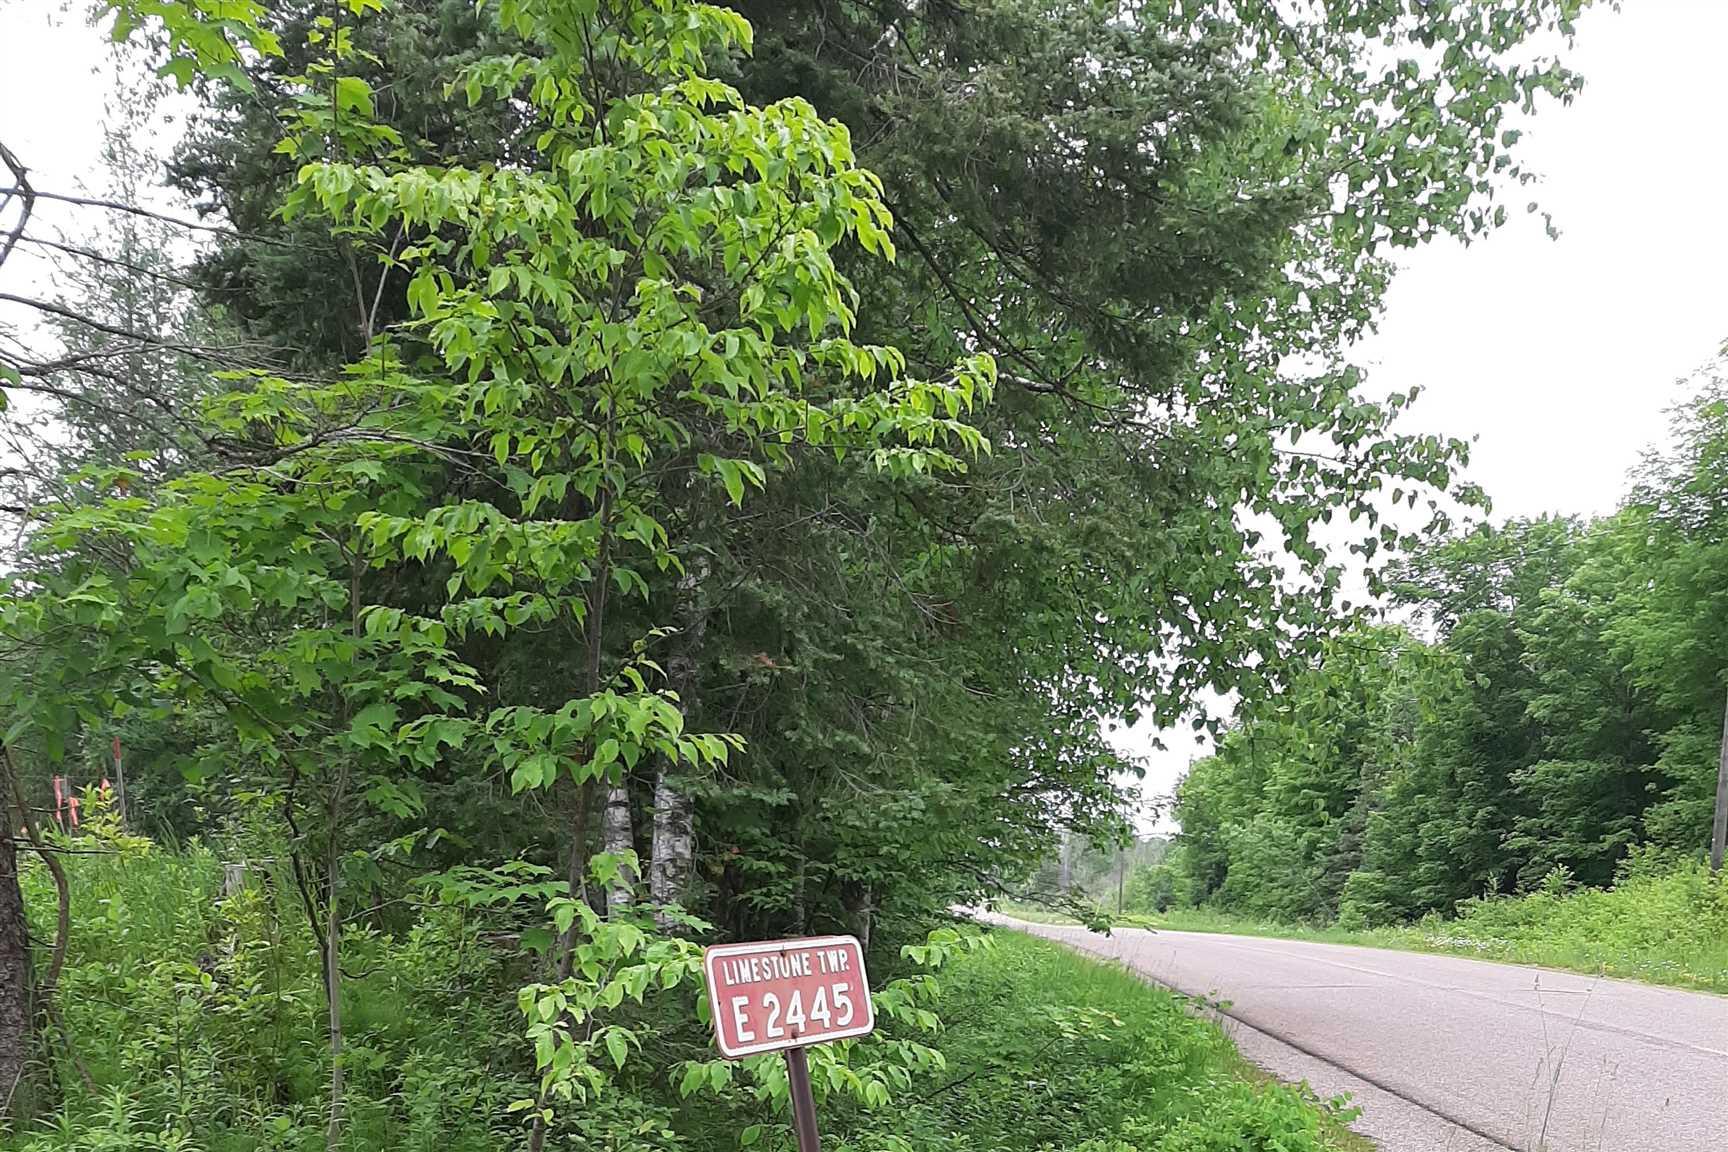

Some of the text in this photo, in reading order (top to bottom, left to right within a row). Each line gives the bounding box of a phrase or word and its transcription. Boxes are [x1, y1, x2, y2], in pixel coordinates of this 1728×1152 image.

[722, 949, 850, 986] LIMESTONE TWP.
[731, 982, 854, 1043] E 2445
